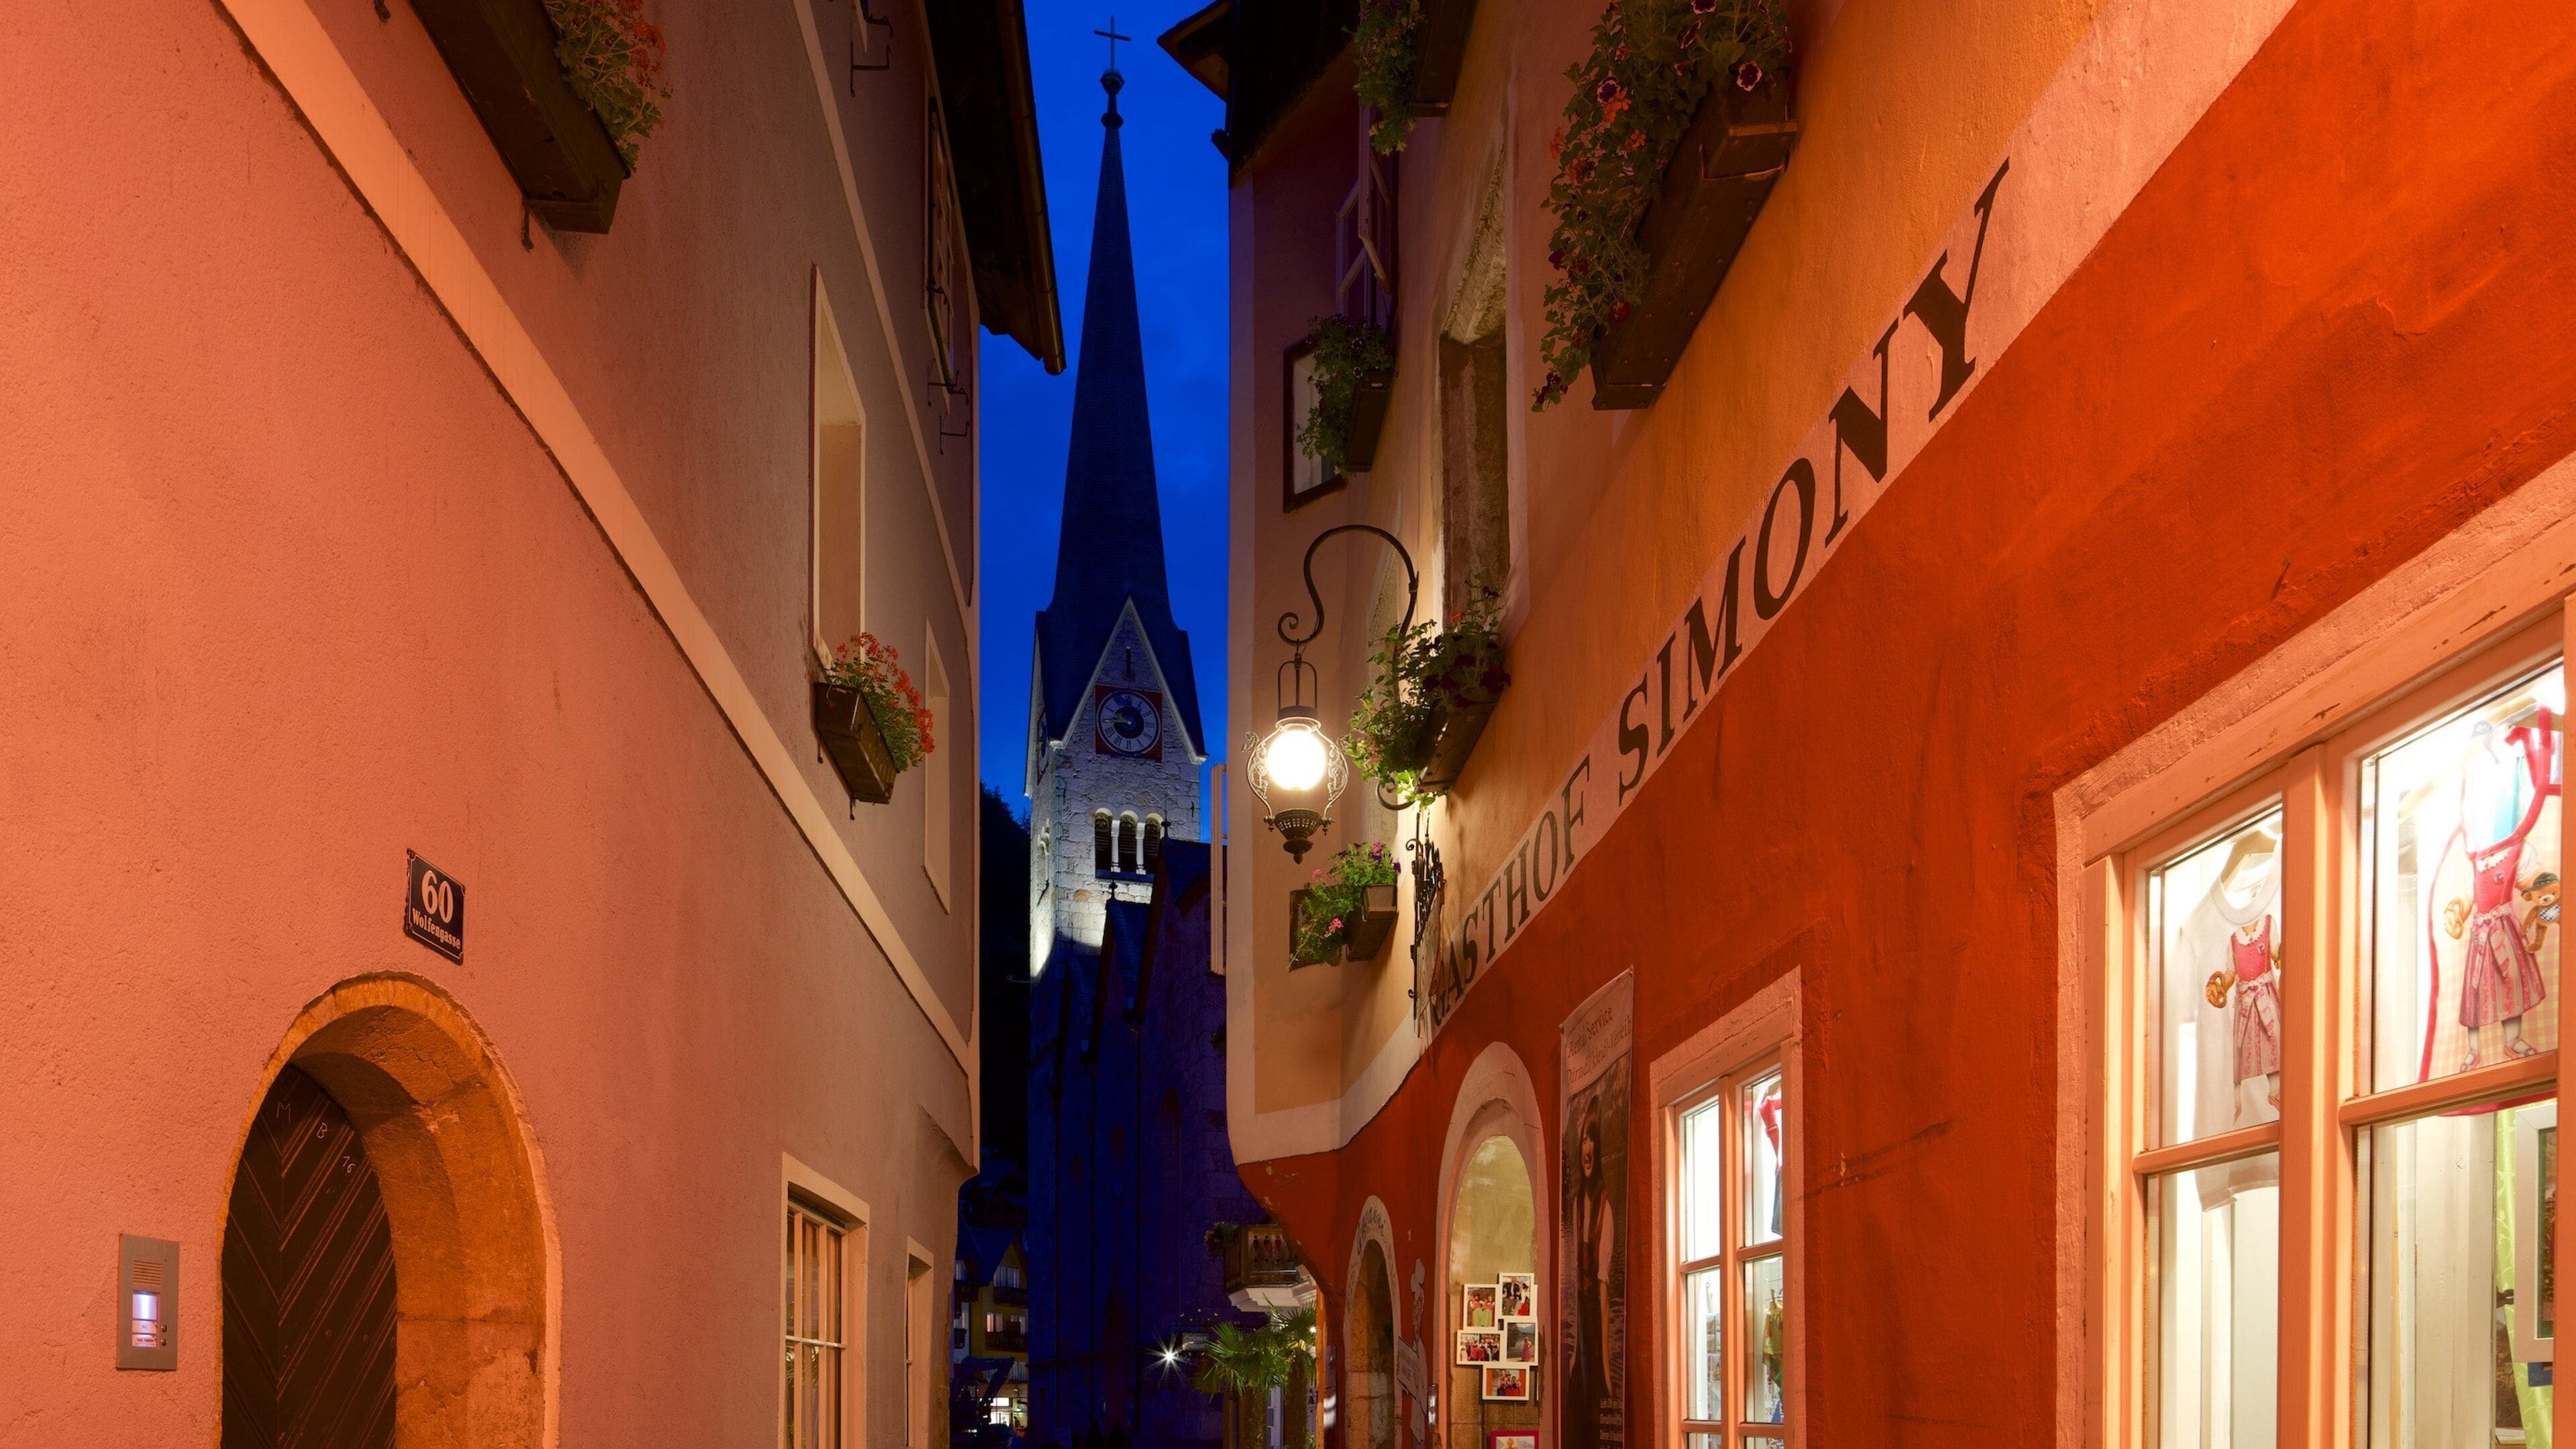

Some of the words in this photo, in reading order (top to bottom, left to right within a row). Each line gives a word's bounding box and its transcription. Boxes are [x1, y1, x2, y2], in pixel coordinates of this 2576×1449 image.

[1618, 157, 2010, 808] SIMONY
[422, 870, 453, 924] 60
[412, 908, 461, 950] Wolfengasse
[1568, 1026, 1587, 1059] Rental
[1587, 1008, 1613, 1039] Service
[316, 1122, 328, 1139] B
